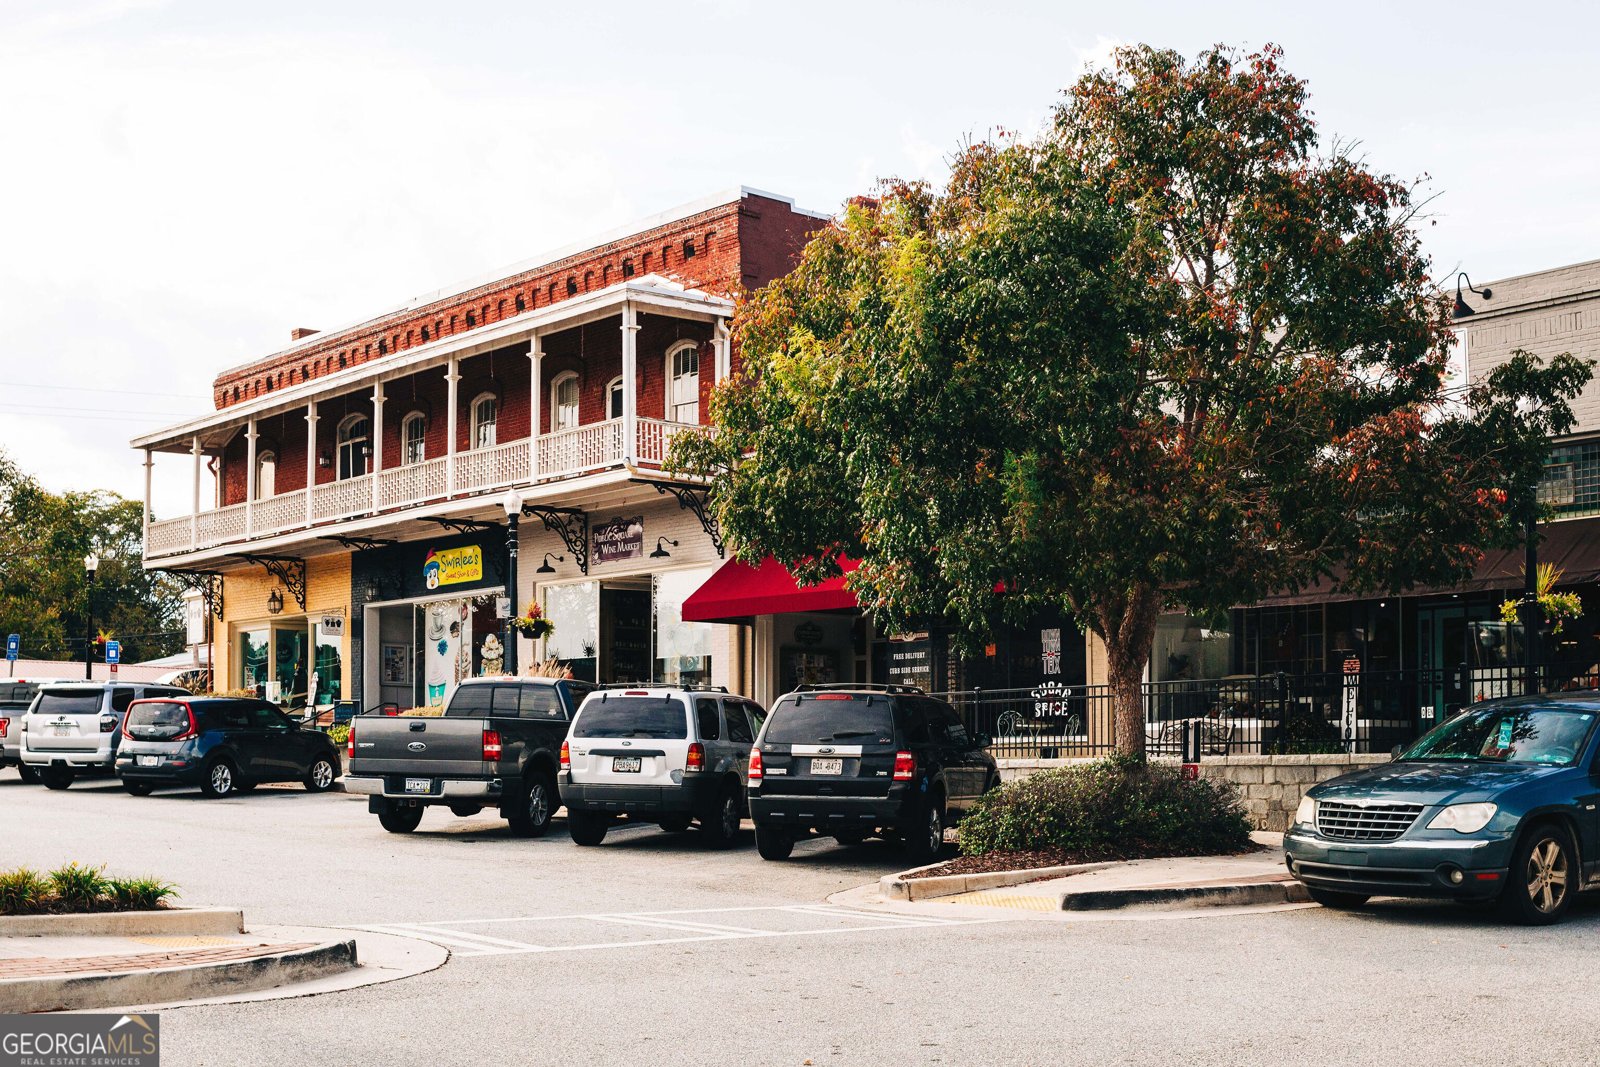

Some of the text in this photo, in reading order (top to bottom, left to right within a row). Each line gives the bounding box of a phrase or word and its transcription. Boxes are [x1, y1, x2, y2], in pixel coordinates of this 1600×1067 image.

[601, 541, 640, 554] WINE MARKET
[905, 652, 925, 660] DELIVERY
[1041, 656, 1061, 674] TUX
